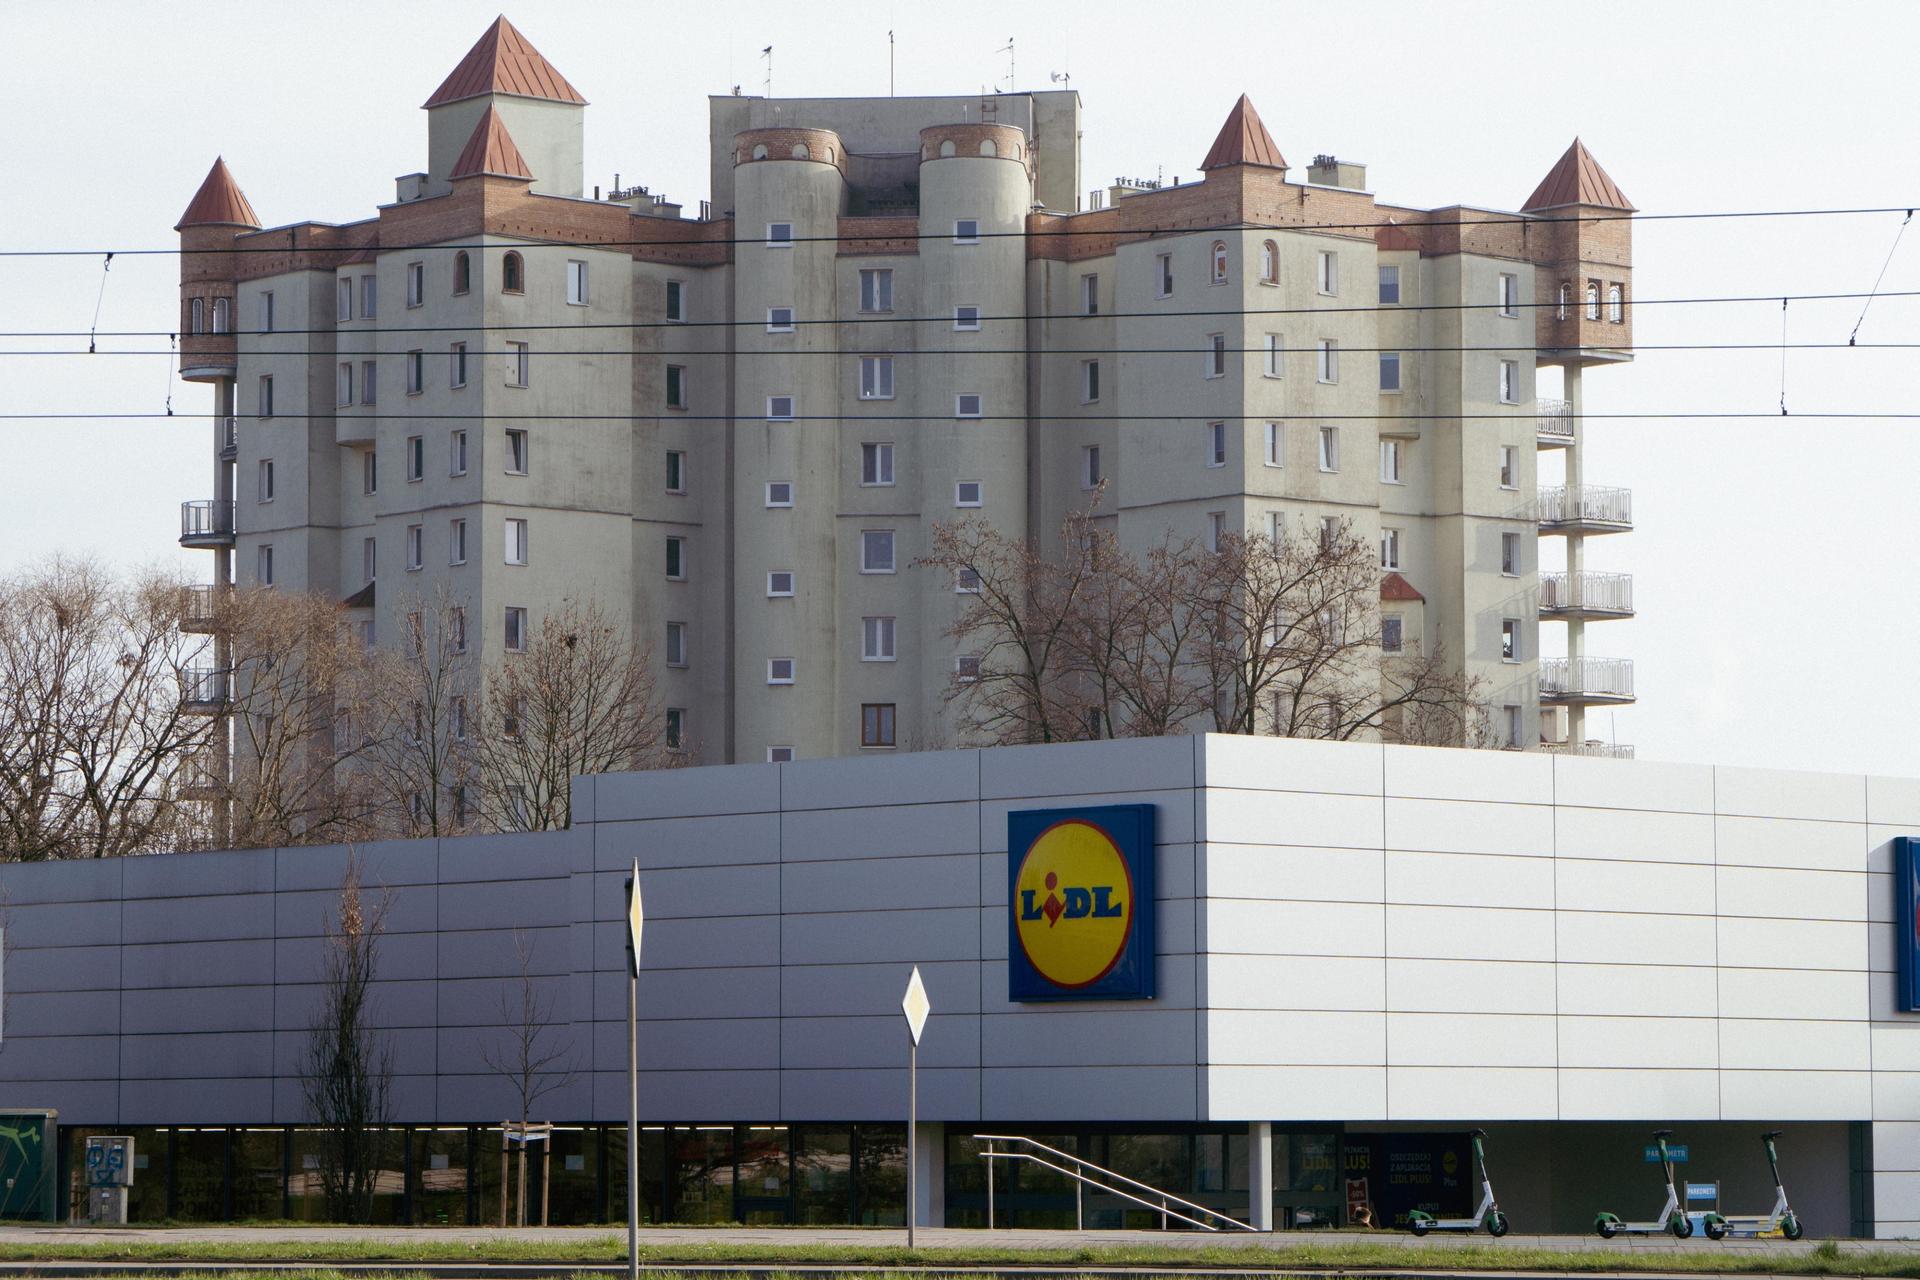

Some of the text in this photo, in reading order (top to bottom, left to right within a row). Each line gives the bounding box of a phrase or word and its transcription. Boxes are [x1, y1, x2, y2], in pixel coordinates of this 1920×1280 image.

[1021, 872, 1122, 928] LIDL
[1646, 1149, 1686, 1158] PARMETR
[1344, 1154, 1370, 1170] LUS!
[1390, 1174, 1408, 1185] LIDL
